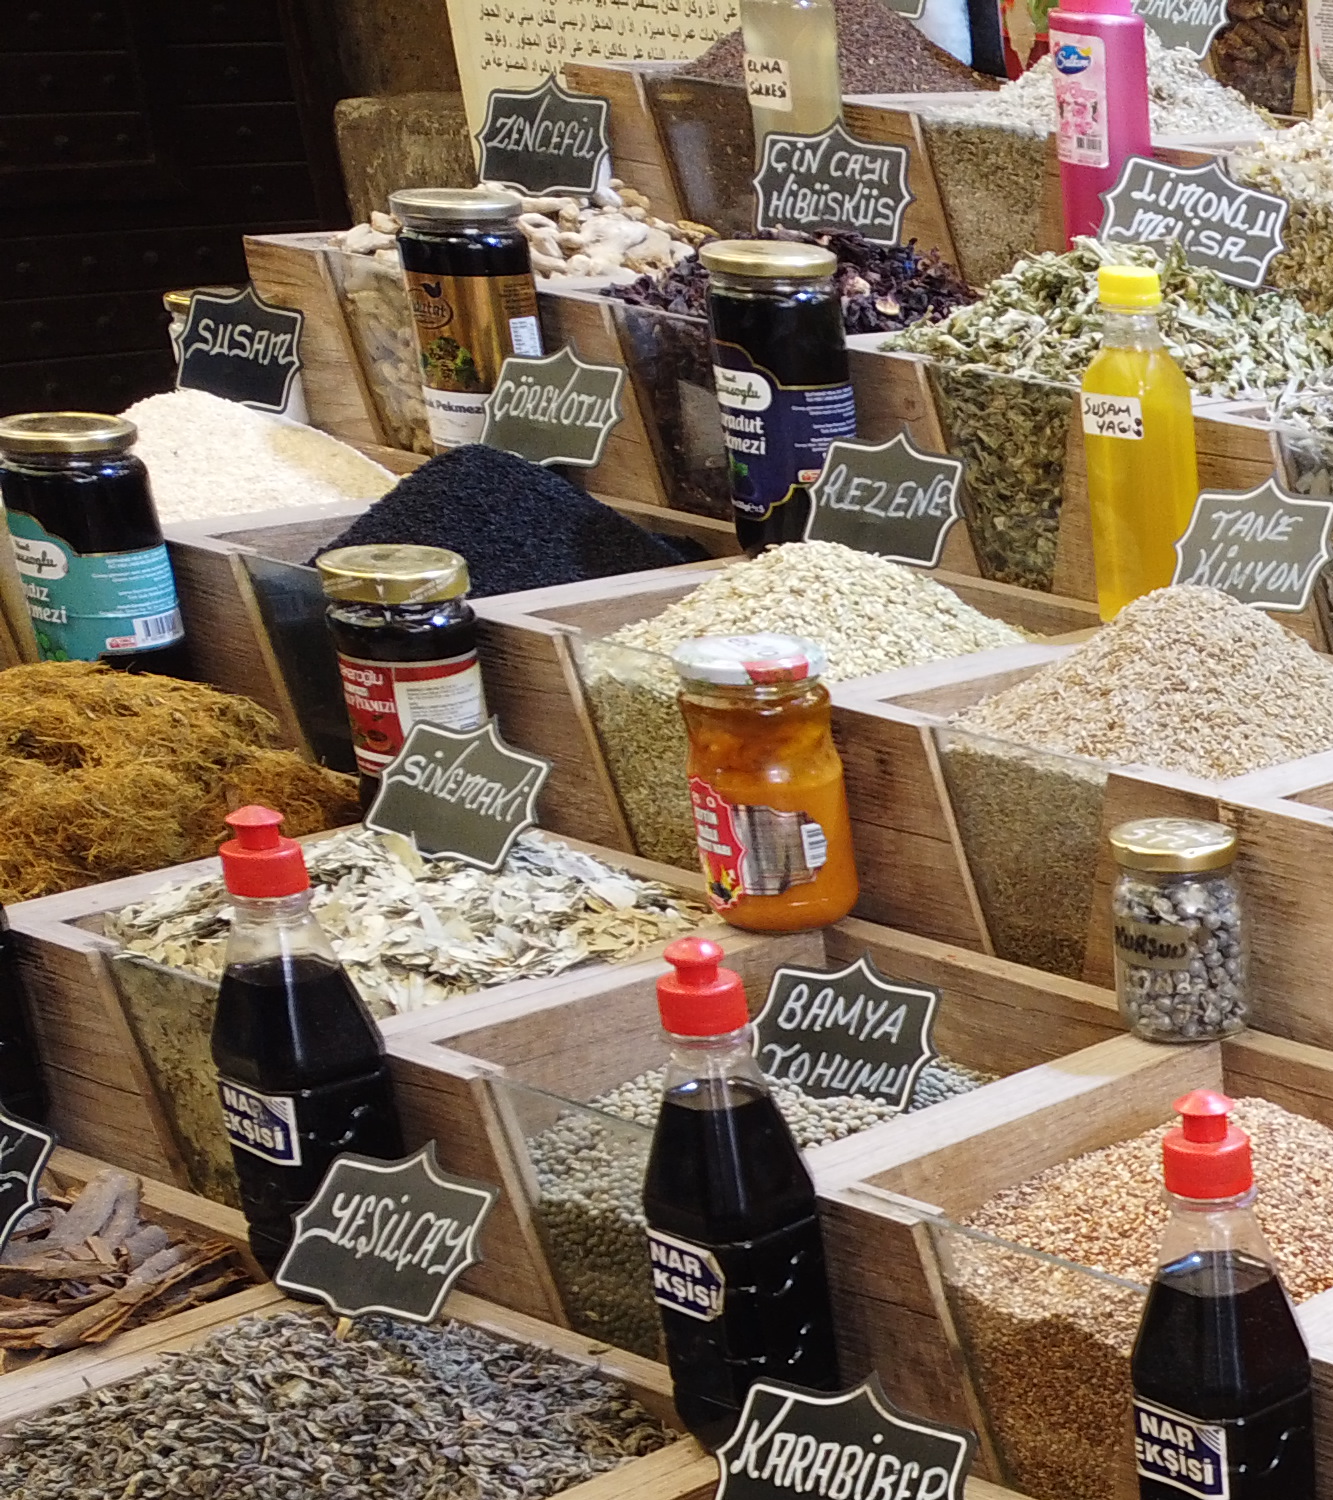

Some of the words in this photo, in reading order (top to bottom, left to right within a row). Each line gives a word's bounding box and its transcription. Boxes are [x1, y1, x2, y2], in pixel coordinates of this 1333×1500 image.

[650, 1241, 703, 1279] NAR
[652, 1267, 718, 1311] KŞİSİ
[1140, 1411, 1196, 1452] NAR
